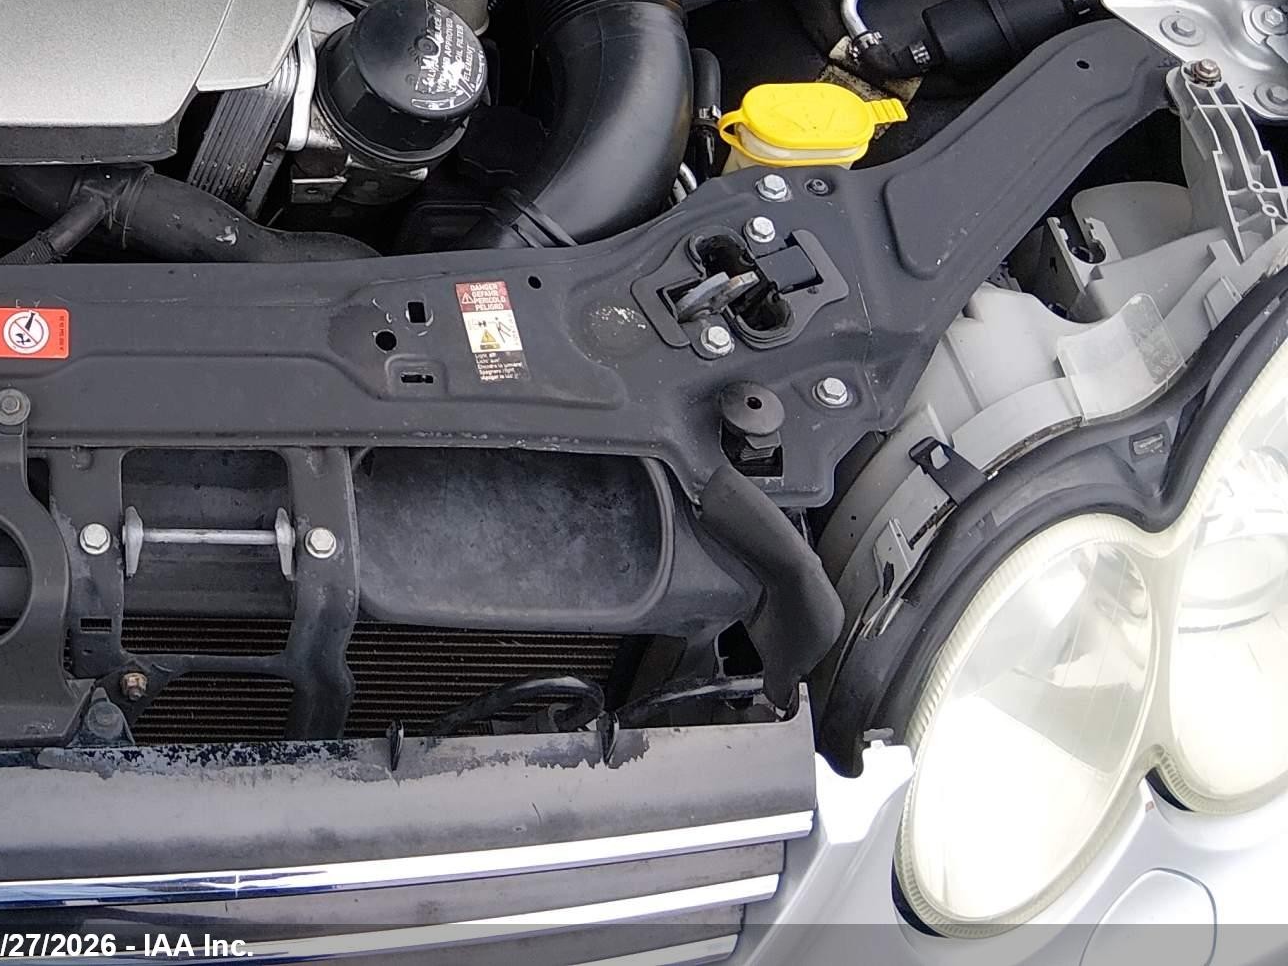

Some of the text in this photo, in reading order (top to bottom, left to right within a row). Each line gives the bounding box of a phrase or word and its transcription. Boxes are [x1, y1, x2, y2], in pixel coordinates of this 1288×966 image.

[444, 17, 453, 57] APPROVED
[456, 24, 464, 48] FILTER
[463, 45, 475, 82] ELEMENT
[470, 282, 498, 290] DANGER
